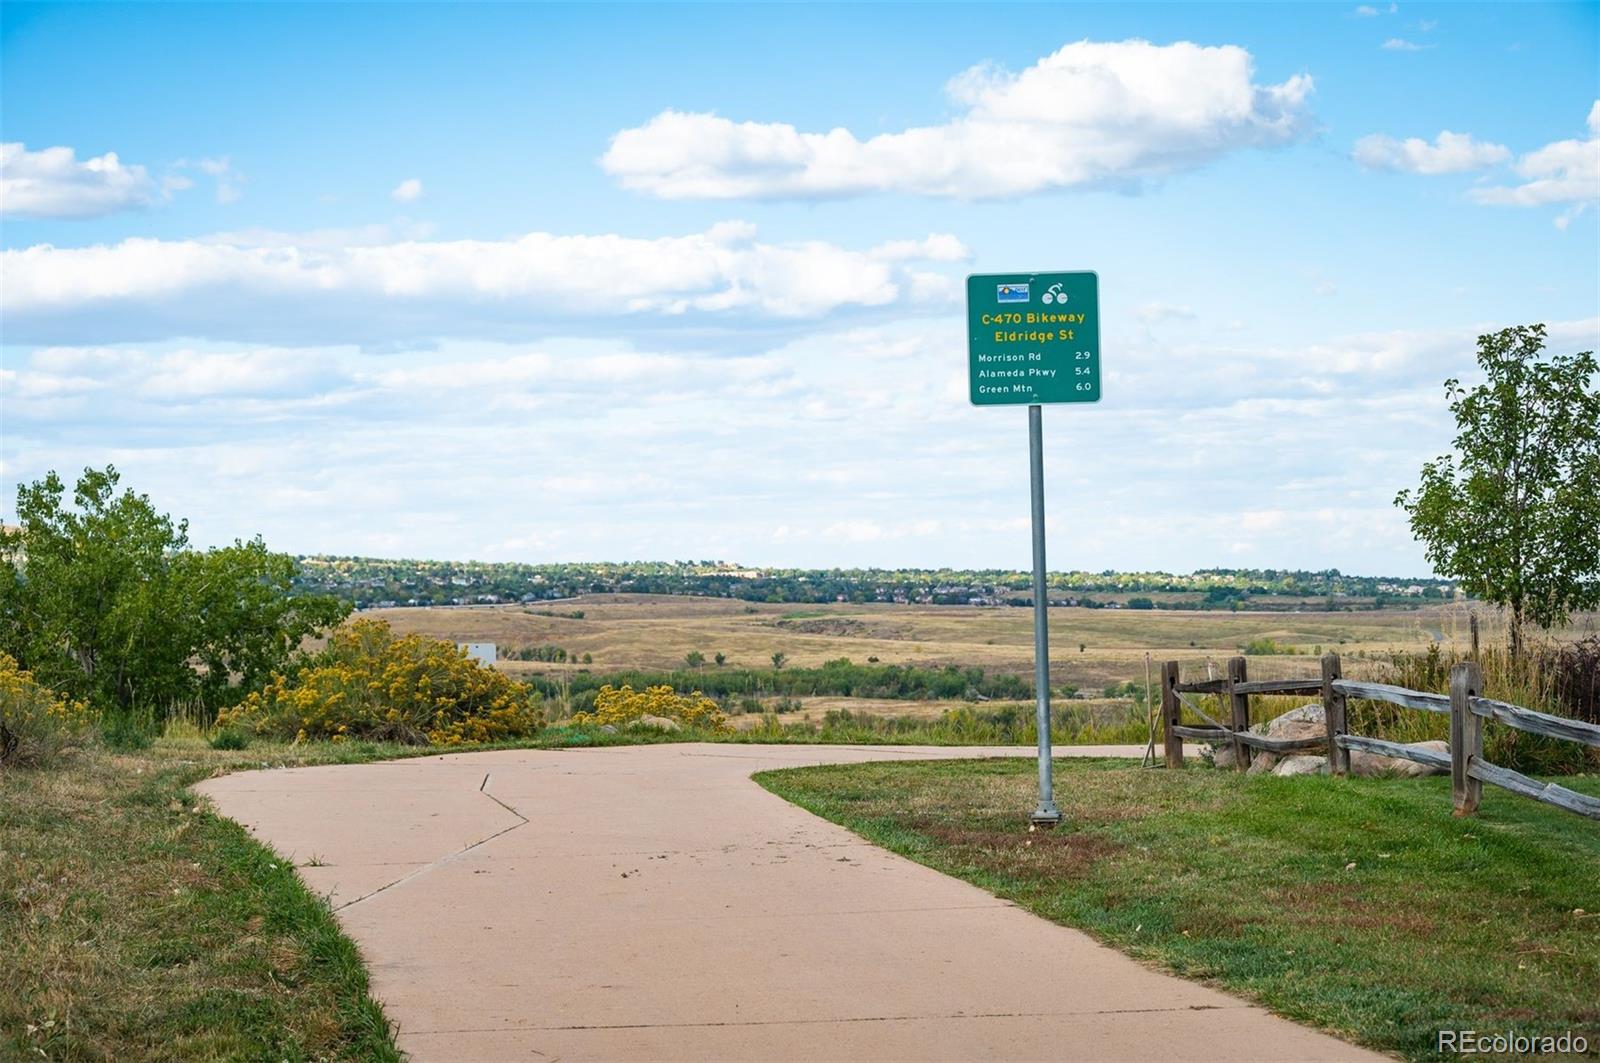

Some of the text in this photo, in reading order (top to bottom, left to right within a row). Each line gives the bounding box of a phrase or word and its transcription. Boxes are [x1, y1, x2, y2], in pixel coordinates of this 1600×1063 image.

[982, 313, 1085, 324] C-470 Bikeway
[995, 330, 1074, 343] Eldridge St
[978, 352, 1041, 362] Morrison Rd
[1075, 352, 1090, 360] 2.9
[979, 368, 1056, 378] Alameda Pkwy
[1075, 367, 1090, 375] 5.4
[979, 384, 1032, 393] Green Mtn
[1076, 382, 1092, 390] 6.0
